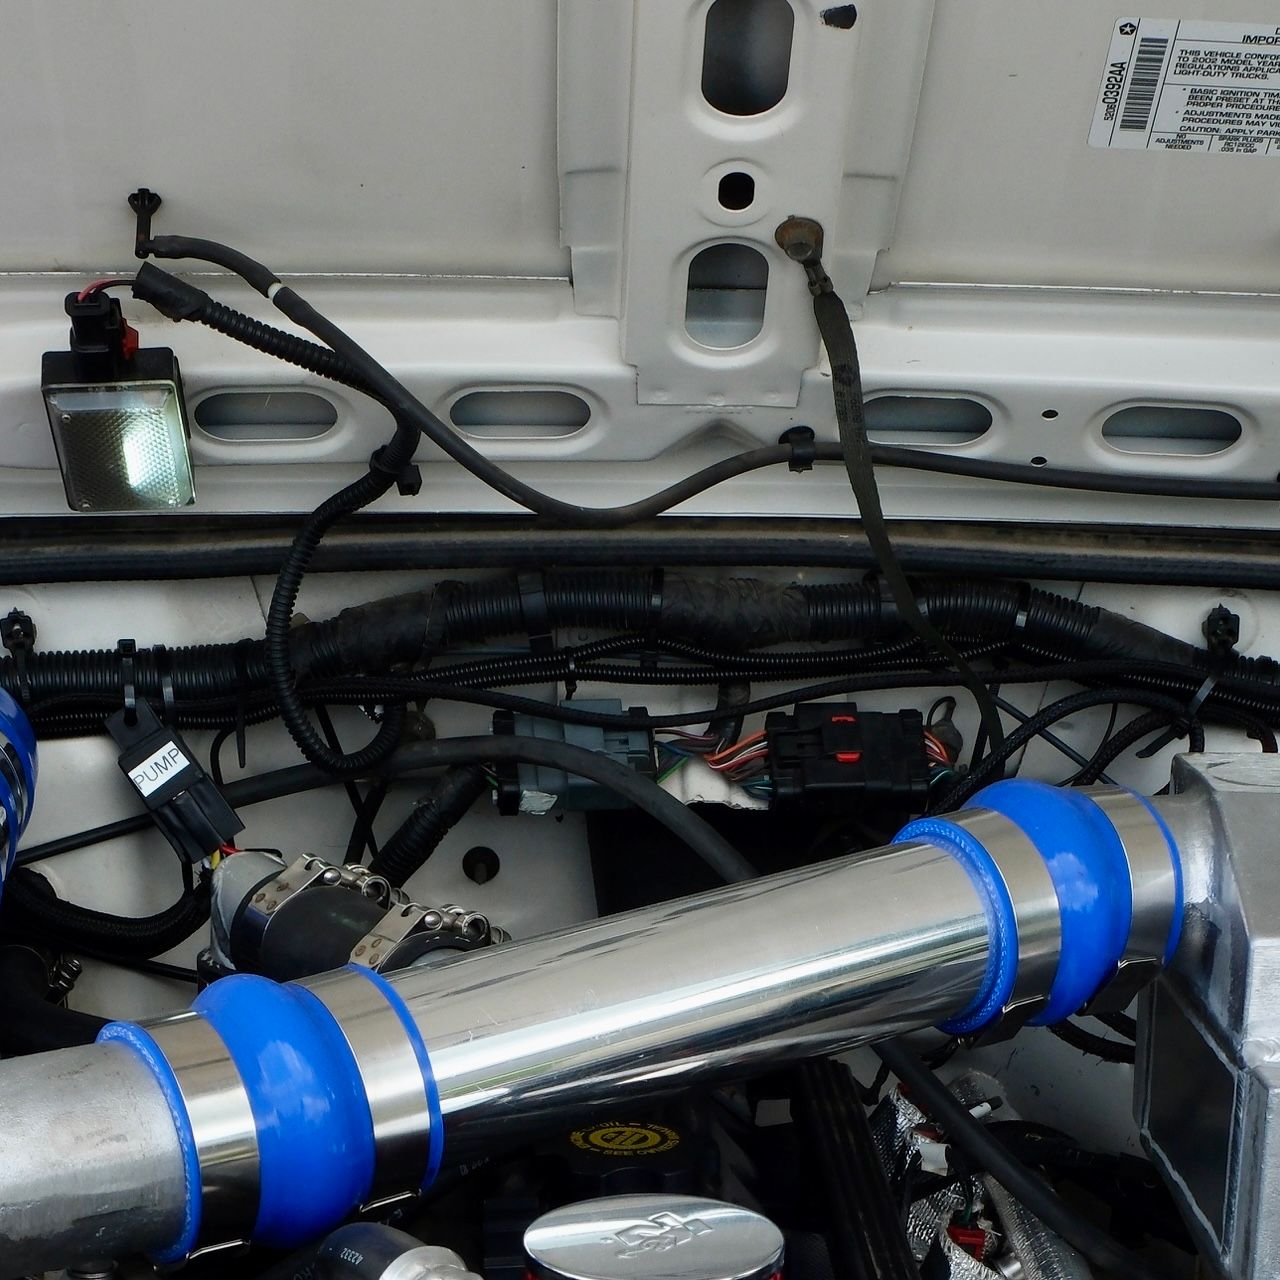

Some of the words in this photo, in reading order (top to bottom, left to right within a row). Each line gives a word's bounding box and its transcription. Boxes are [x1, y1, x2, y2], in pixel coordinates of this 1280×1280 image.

[1175, 62, 1239, 71] REGULATIONS
[1173, 69, 1226, 77] LIGHT-DUTY
[1221, 89, 1259, 97] IGNITION
[1183, 109, 1251, 118] ADJUSTMENTS
[1181, 116, 1242, 125] PROCEDURES
[133, 747, 178, 790] PUMP
